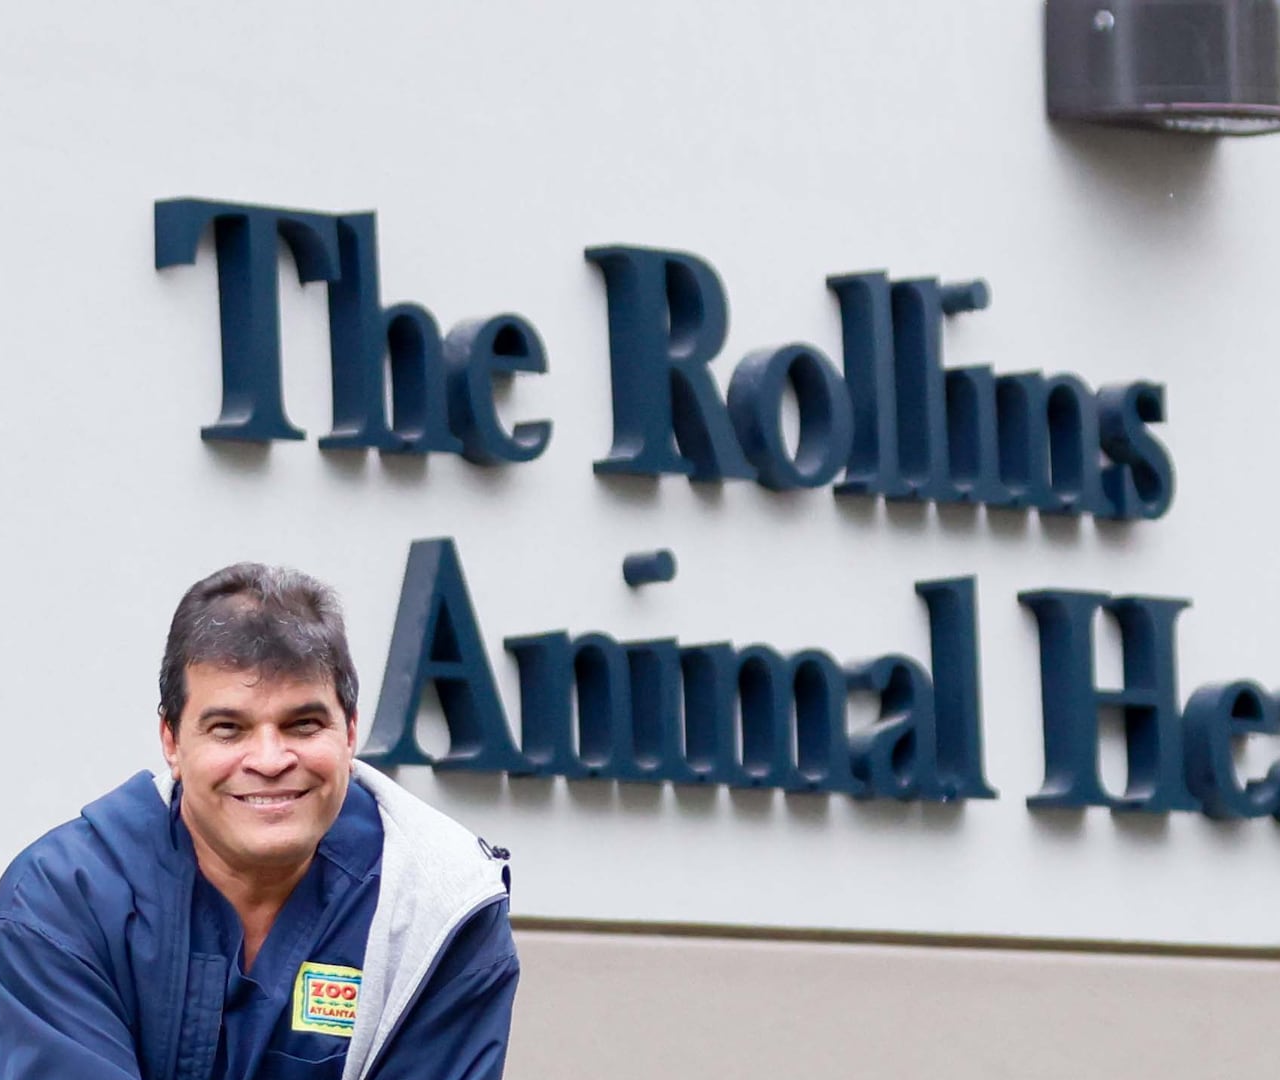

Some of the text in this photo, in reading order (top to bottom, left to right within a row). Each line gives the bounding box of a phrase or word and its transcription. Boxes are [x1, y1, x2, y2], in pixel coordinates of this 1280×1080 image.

[154, 197, 1175, 521] The Rollins
[357, 537, 1000, 803] Animal
[309, 1006, 357, 1019] ATLANTA
[311, 981, 357, 1000] ZOO
